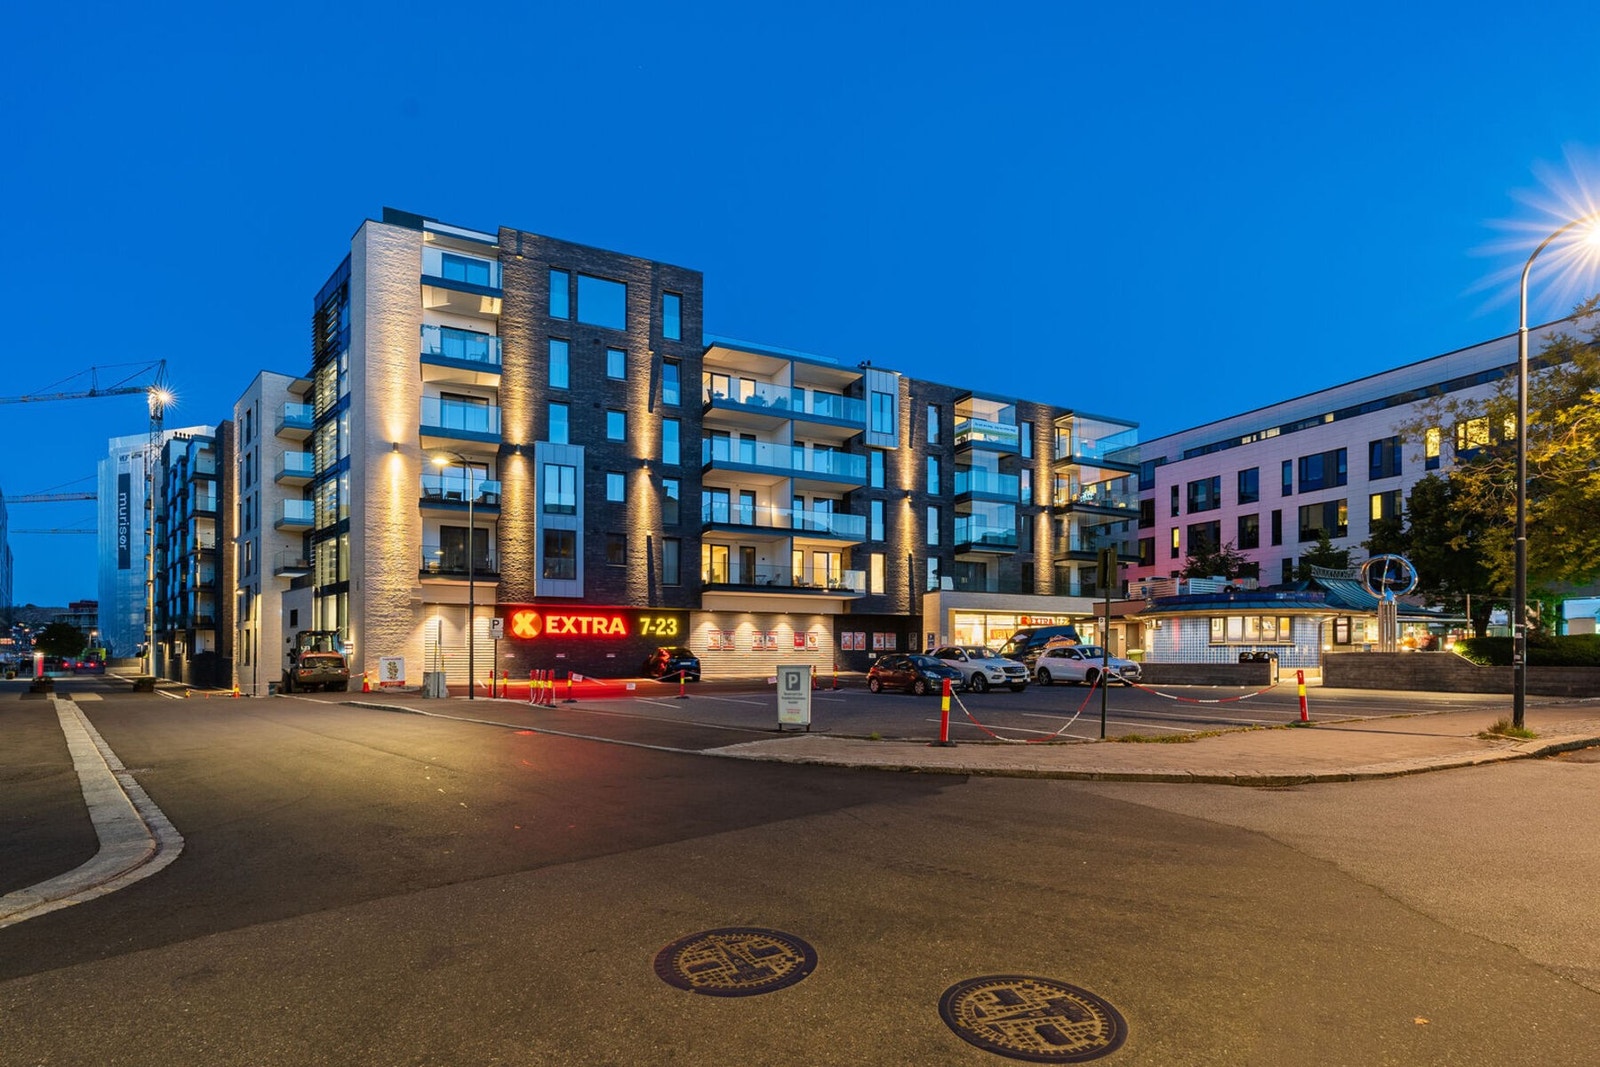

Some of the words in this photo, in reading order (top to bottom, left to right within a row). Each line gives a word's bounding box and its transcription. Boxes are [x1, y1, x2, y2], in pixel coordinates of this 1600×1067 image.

[119, 492, 130, 551] murisør
[492, 619, 500, 630] P
[546, 615, 626, 634] EXTRA
[640, 617, 677, 635] 7-23
[788, 673, 799, 690] P
